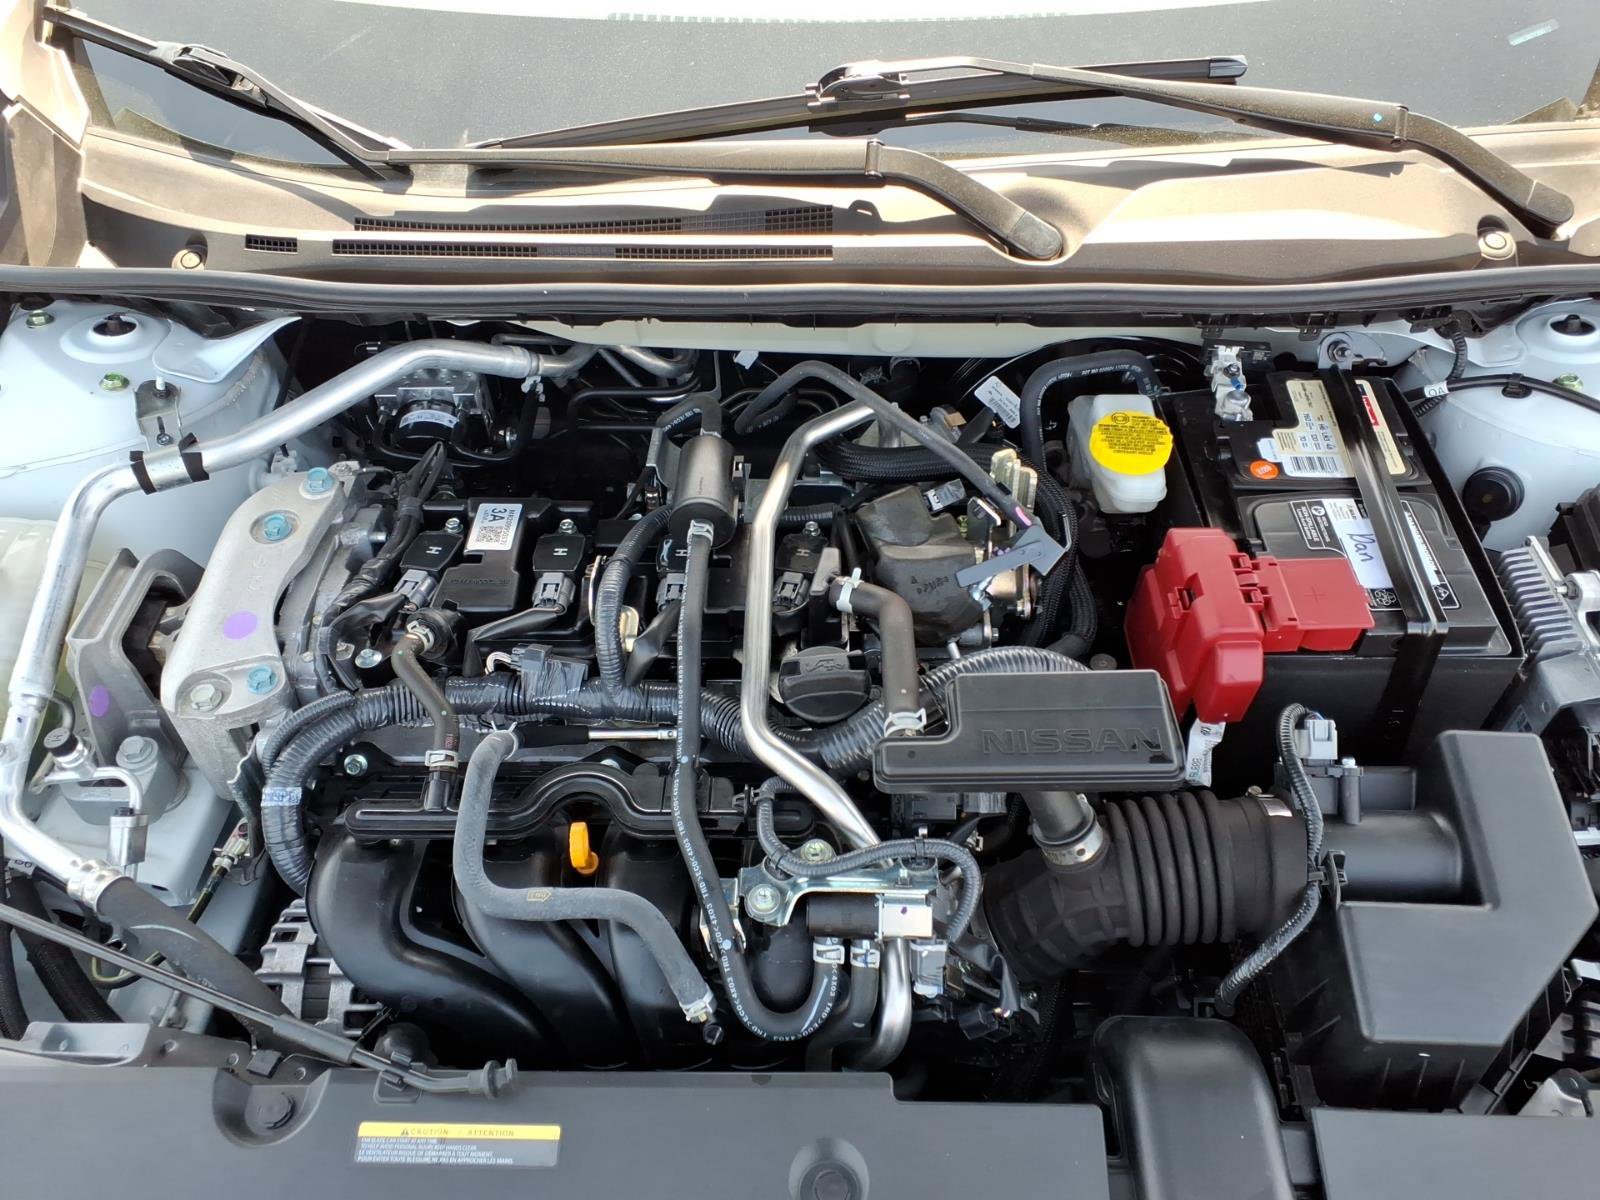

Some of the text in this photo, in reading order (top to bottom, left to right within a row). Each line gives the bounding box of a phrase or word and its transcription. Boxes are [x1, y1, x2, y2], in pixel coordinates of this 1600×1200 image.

[488, 508, 508, 522] 3A
[425, 546, 442, 554] H
[982, 728, 1162, 755] NISSAN
